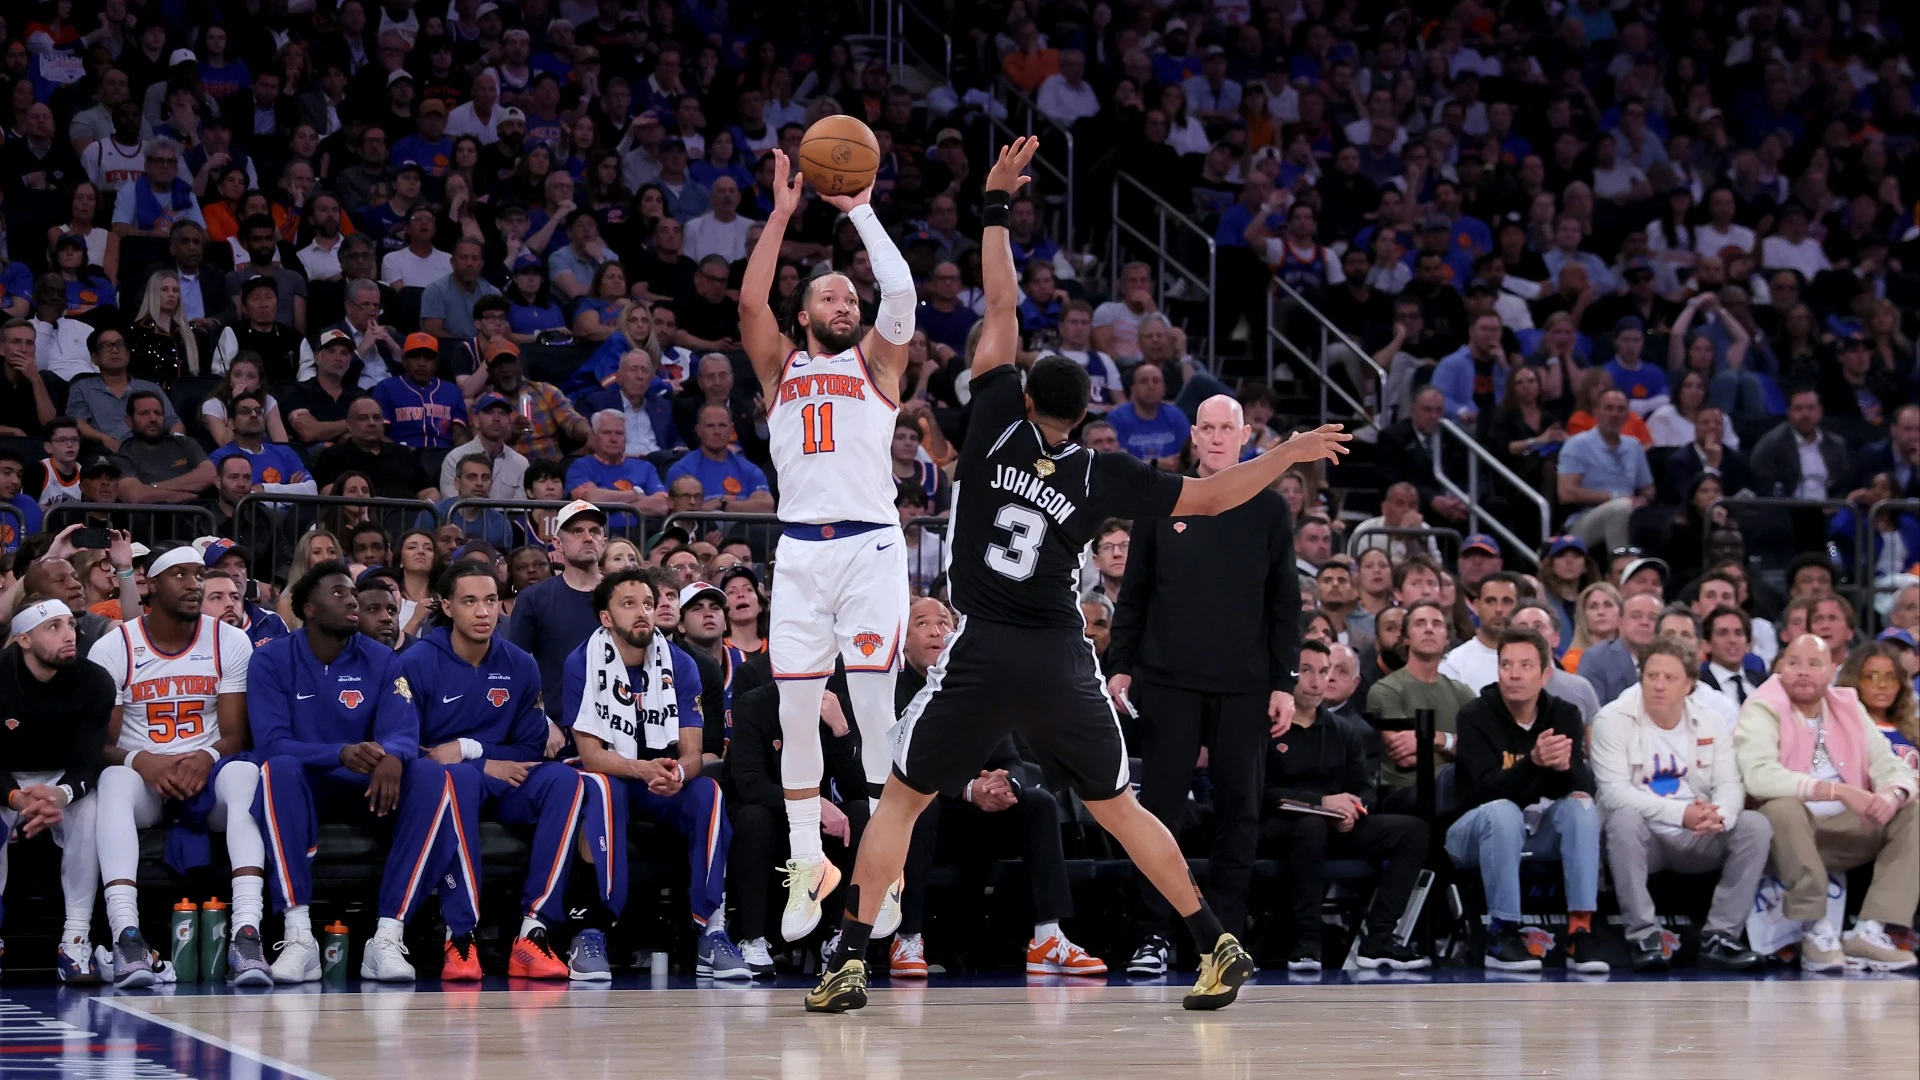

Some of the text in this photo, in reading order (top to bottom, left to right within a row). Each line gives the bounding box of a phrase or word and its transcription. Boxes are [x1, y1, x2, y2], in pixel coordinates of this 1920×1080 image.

[781, 374, 865, 407] NEW YORK
[395, 403, 451, 422] NEW YORK
[801, 402, 835, 455] 11
[990, 464, 1076, 525] JOHNSON
[983, 502, 1048, 582] 3
[131, 675, 218, 703] NEW YORK
[147, 701, 205, 743] 55
